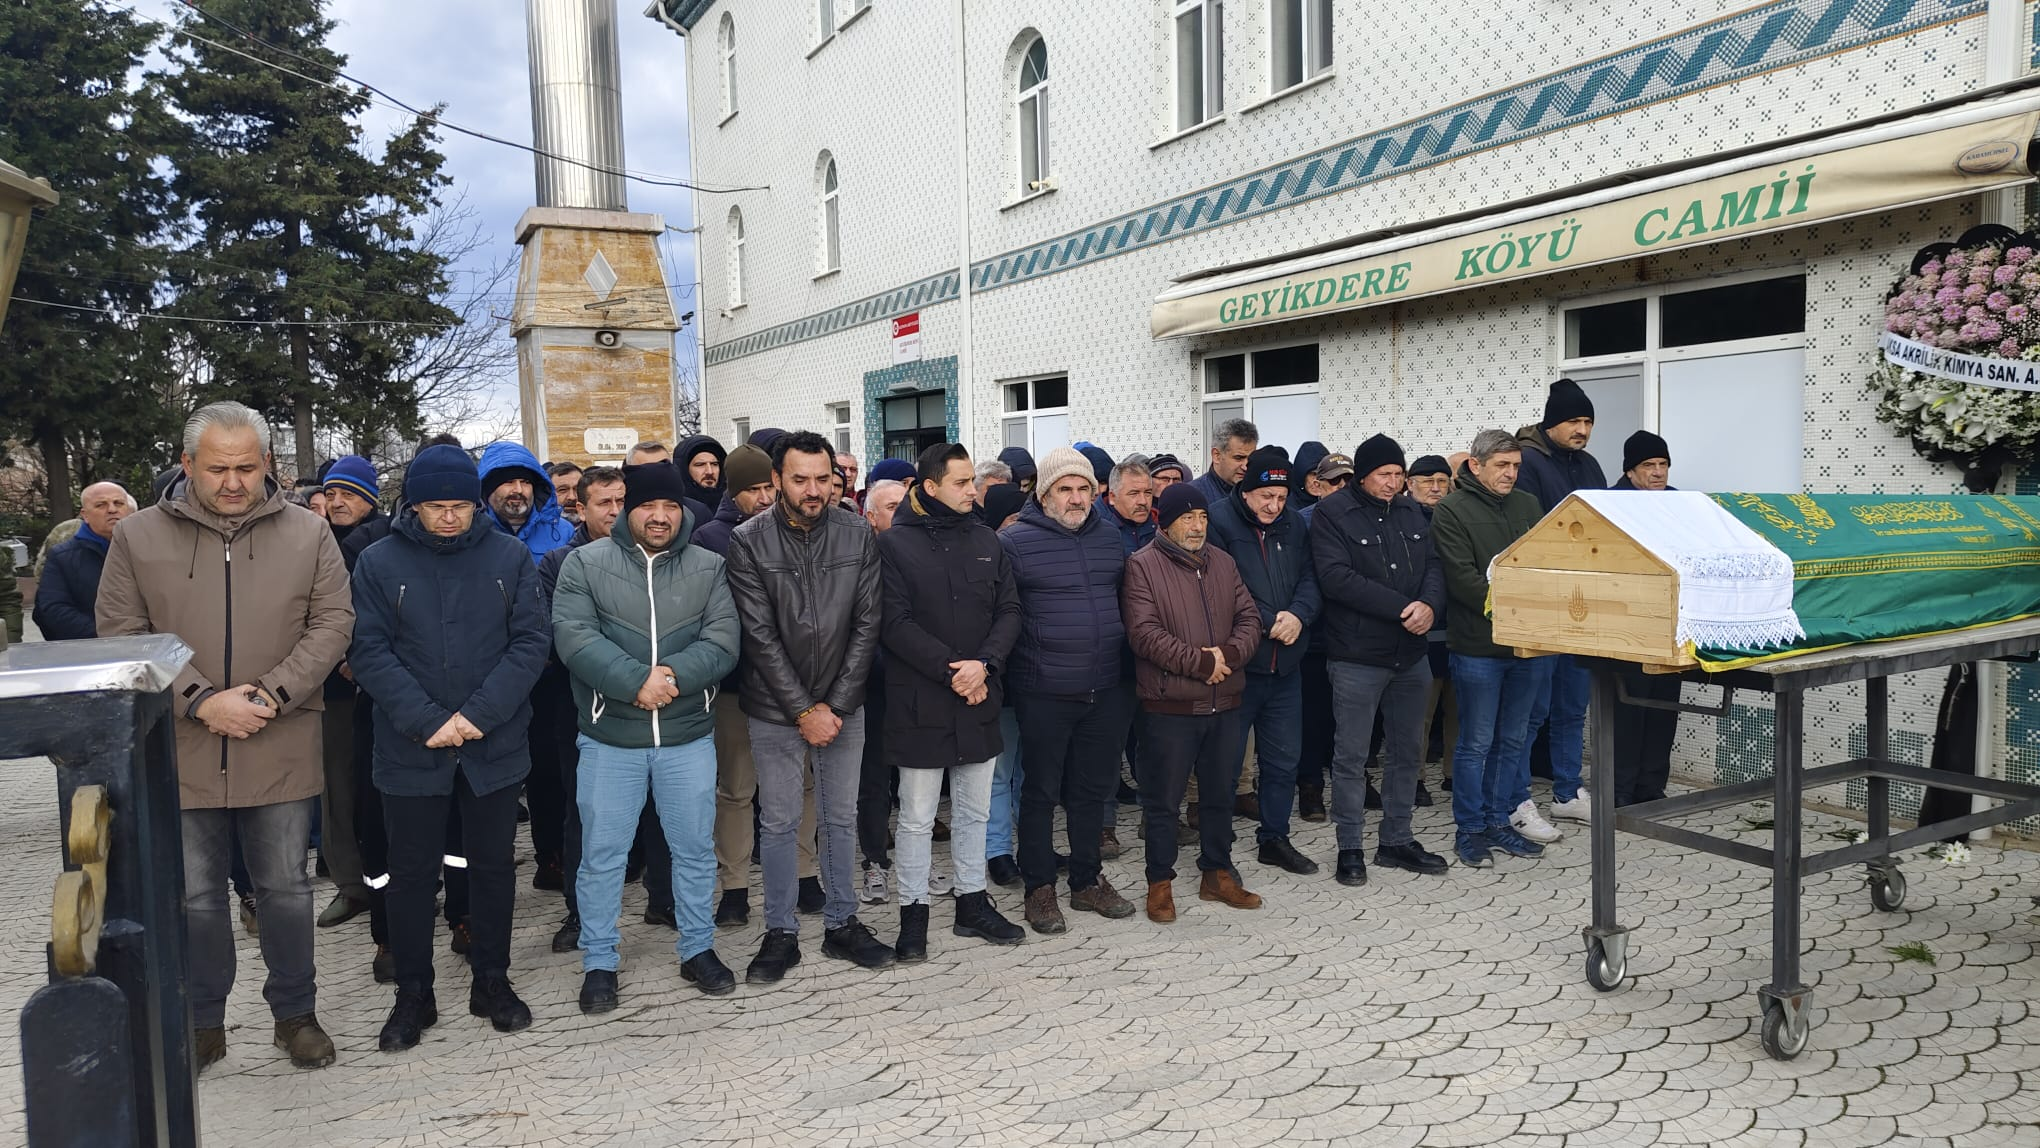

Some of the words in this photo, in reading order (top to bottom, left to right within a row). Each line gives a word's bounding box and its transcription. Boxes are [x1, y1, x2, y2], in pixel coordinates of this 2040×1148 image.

[1219, 262, 1412, 324] GEYİKDERE
[1454, 217, 1582, 281] KÖYÜ
[1633, 164, 1816, 247] CAMİİ
[1943, 354, 1983, 378] KİMYA
[1987, 364, 2020, 383] SAN.
